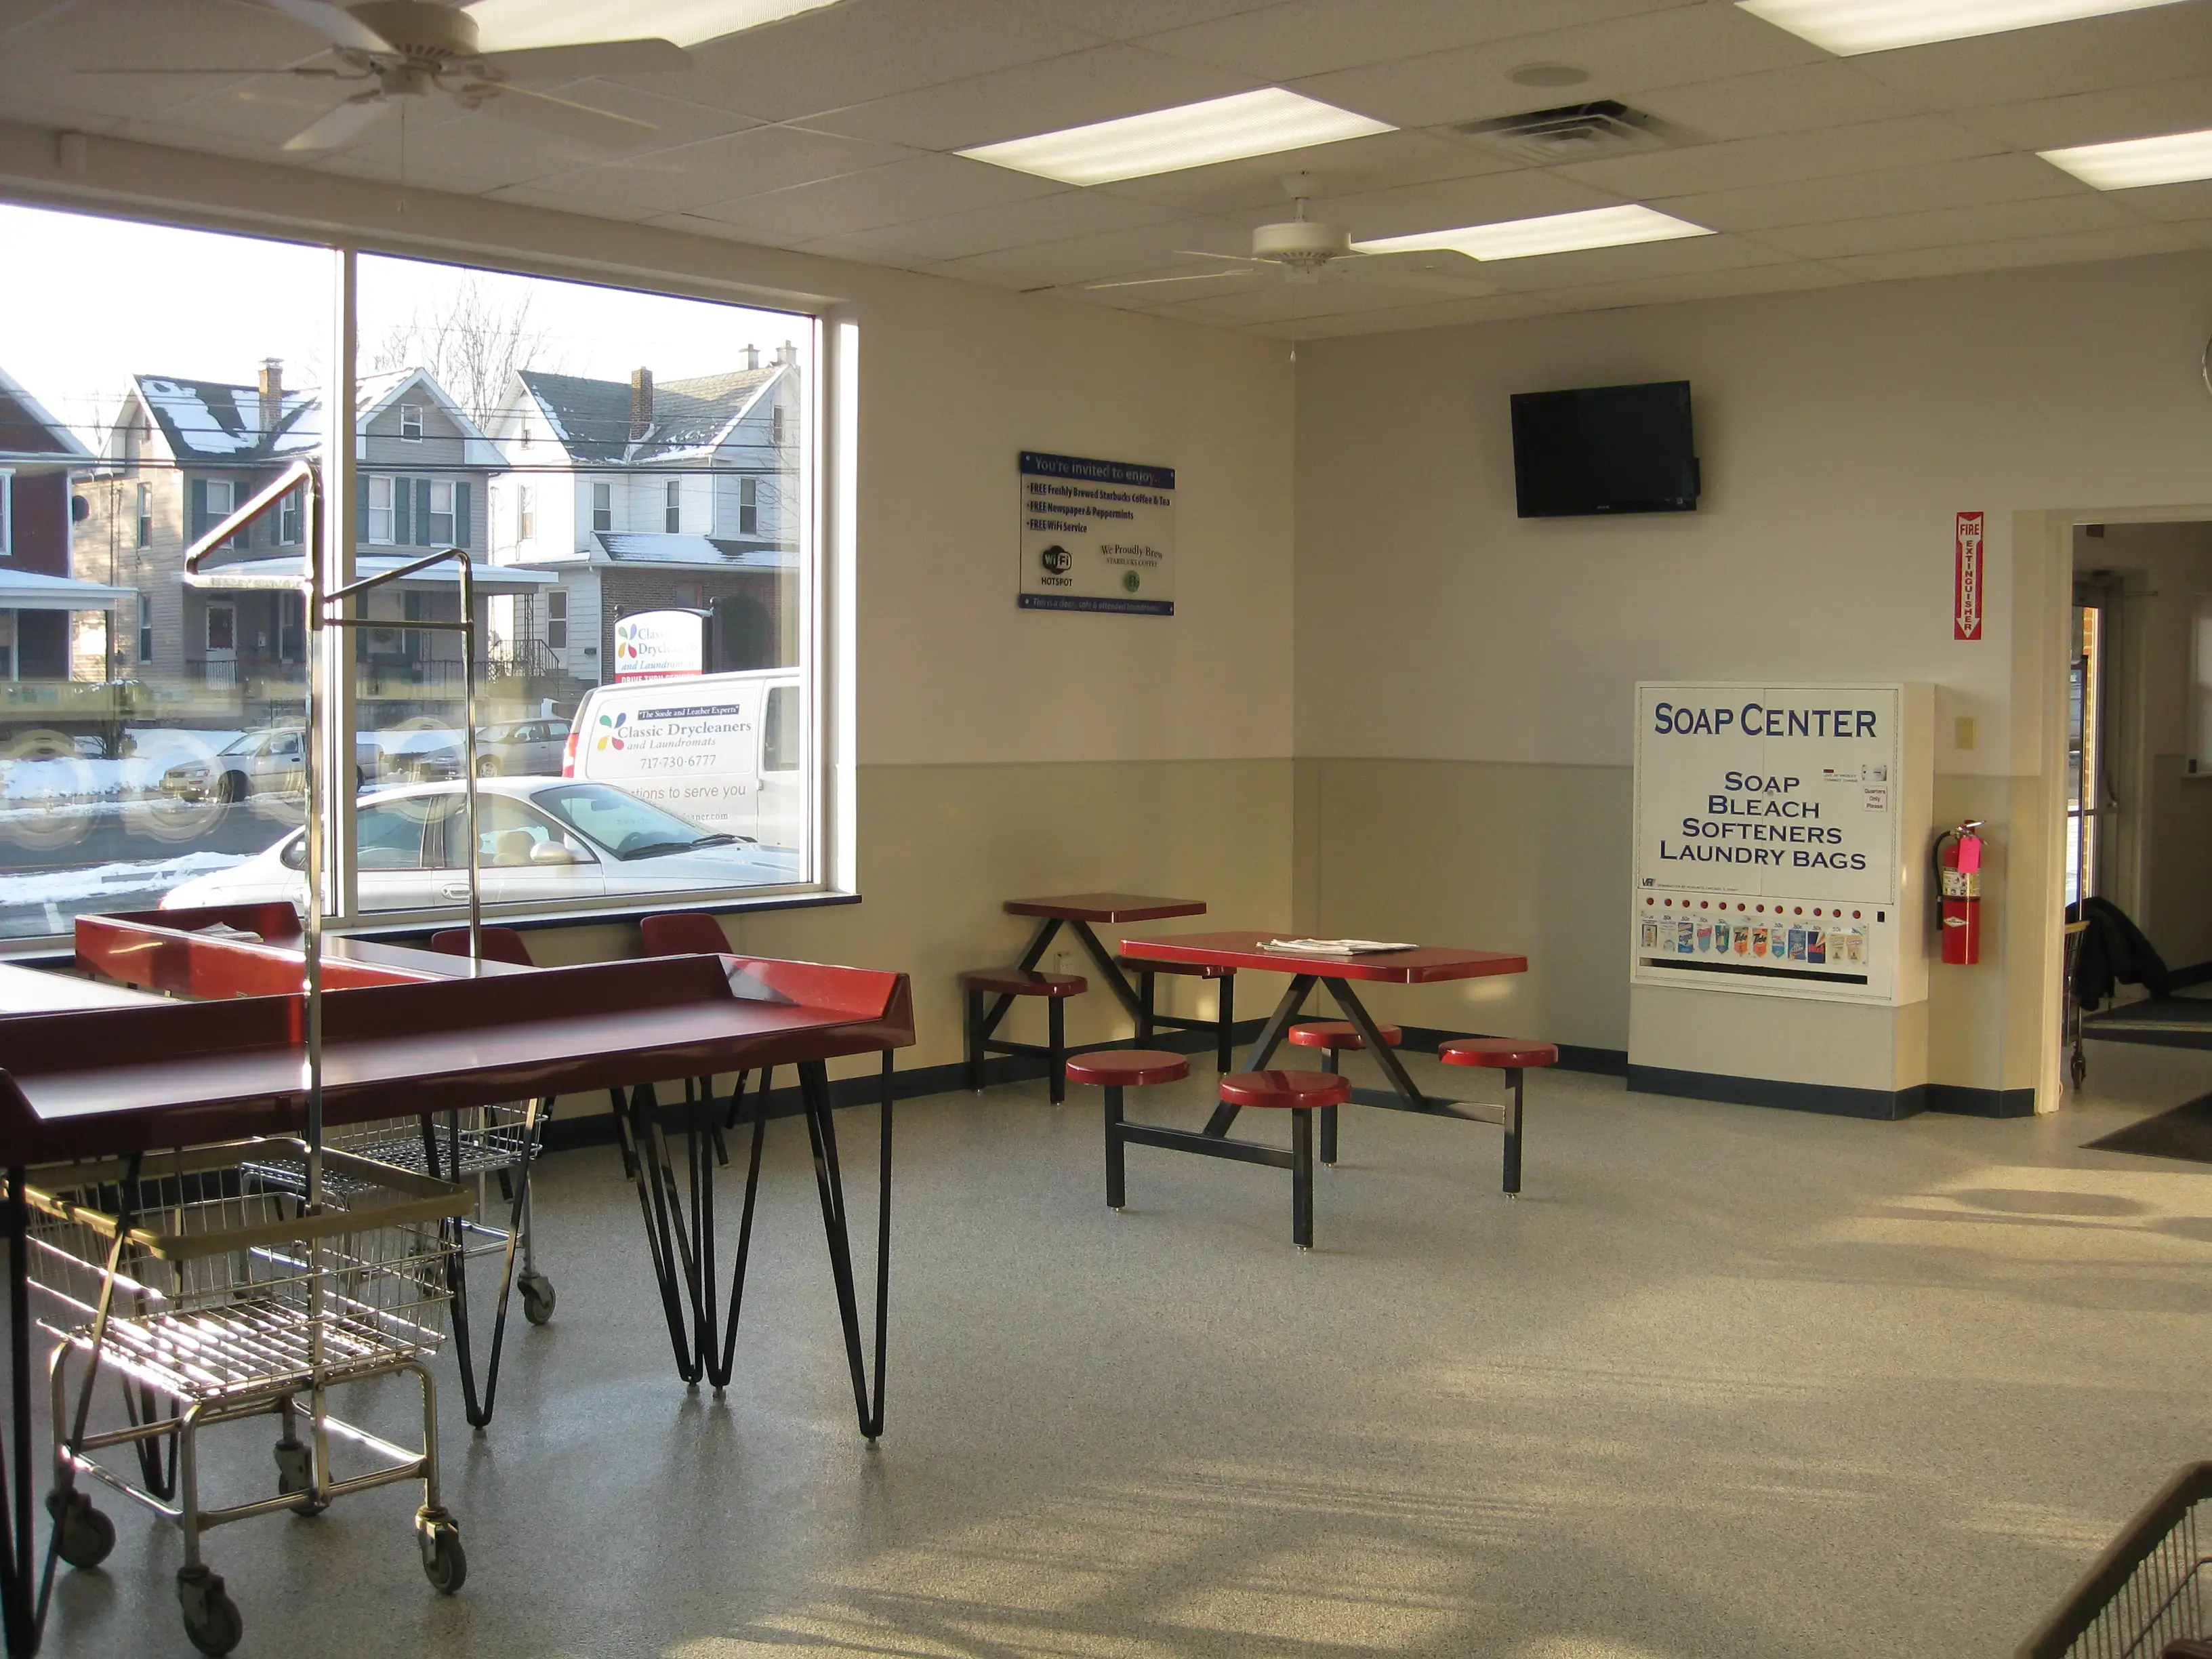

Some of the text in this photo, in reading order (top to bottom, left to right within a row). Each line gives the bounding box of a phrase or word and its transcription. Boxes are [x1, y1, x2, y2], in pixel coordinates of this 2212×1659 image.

[1035, 456, 1070, 473] You're
[1072, 461, 1110, 477] invited
[1112, 466, 1124, 478] to
[1030, 483, 1170, 506] FREE Freshly Brewed Starbucks Coffee & Tea
[1030, 501, 1134, 520] FREE Newspaper & Peppermints
[1030, 518, 1046, 531] FREE
[1063, 522, 1088, 533] Service
[1960, 523, 1980, 535] FIRE
[1101, 544, 1164, 560] We Proudly Brew
[1041, 577, 1073, 587] HOTSPOT
[1964, 540, 1973, 631] EXTINGUISHER
[621, 659, 638, 671] and
[673, 708, 686, 716] and
[687, 708, 710, 716] Leather
[1654, 702, 1878, 739] SOAP CENTER
[617, 721, 752, 739] Classic Drycleaners
[627, 737, 716, 751] and Laundromats
[1723, 771, 1801, 794] SOAP
[630, 785, 746, 800] tions to serve you
[1707, 794, 1820, 819] BLEACH
[1681, 817, 1843, 845] SOFTENERS
[1659, 840, 1867, 871] LAUNDRY BAGS
[1734, 932, 1748, 943] Tide
[1753, 933, 1767, 945] Tide
